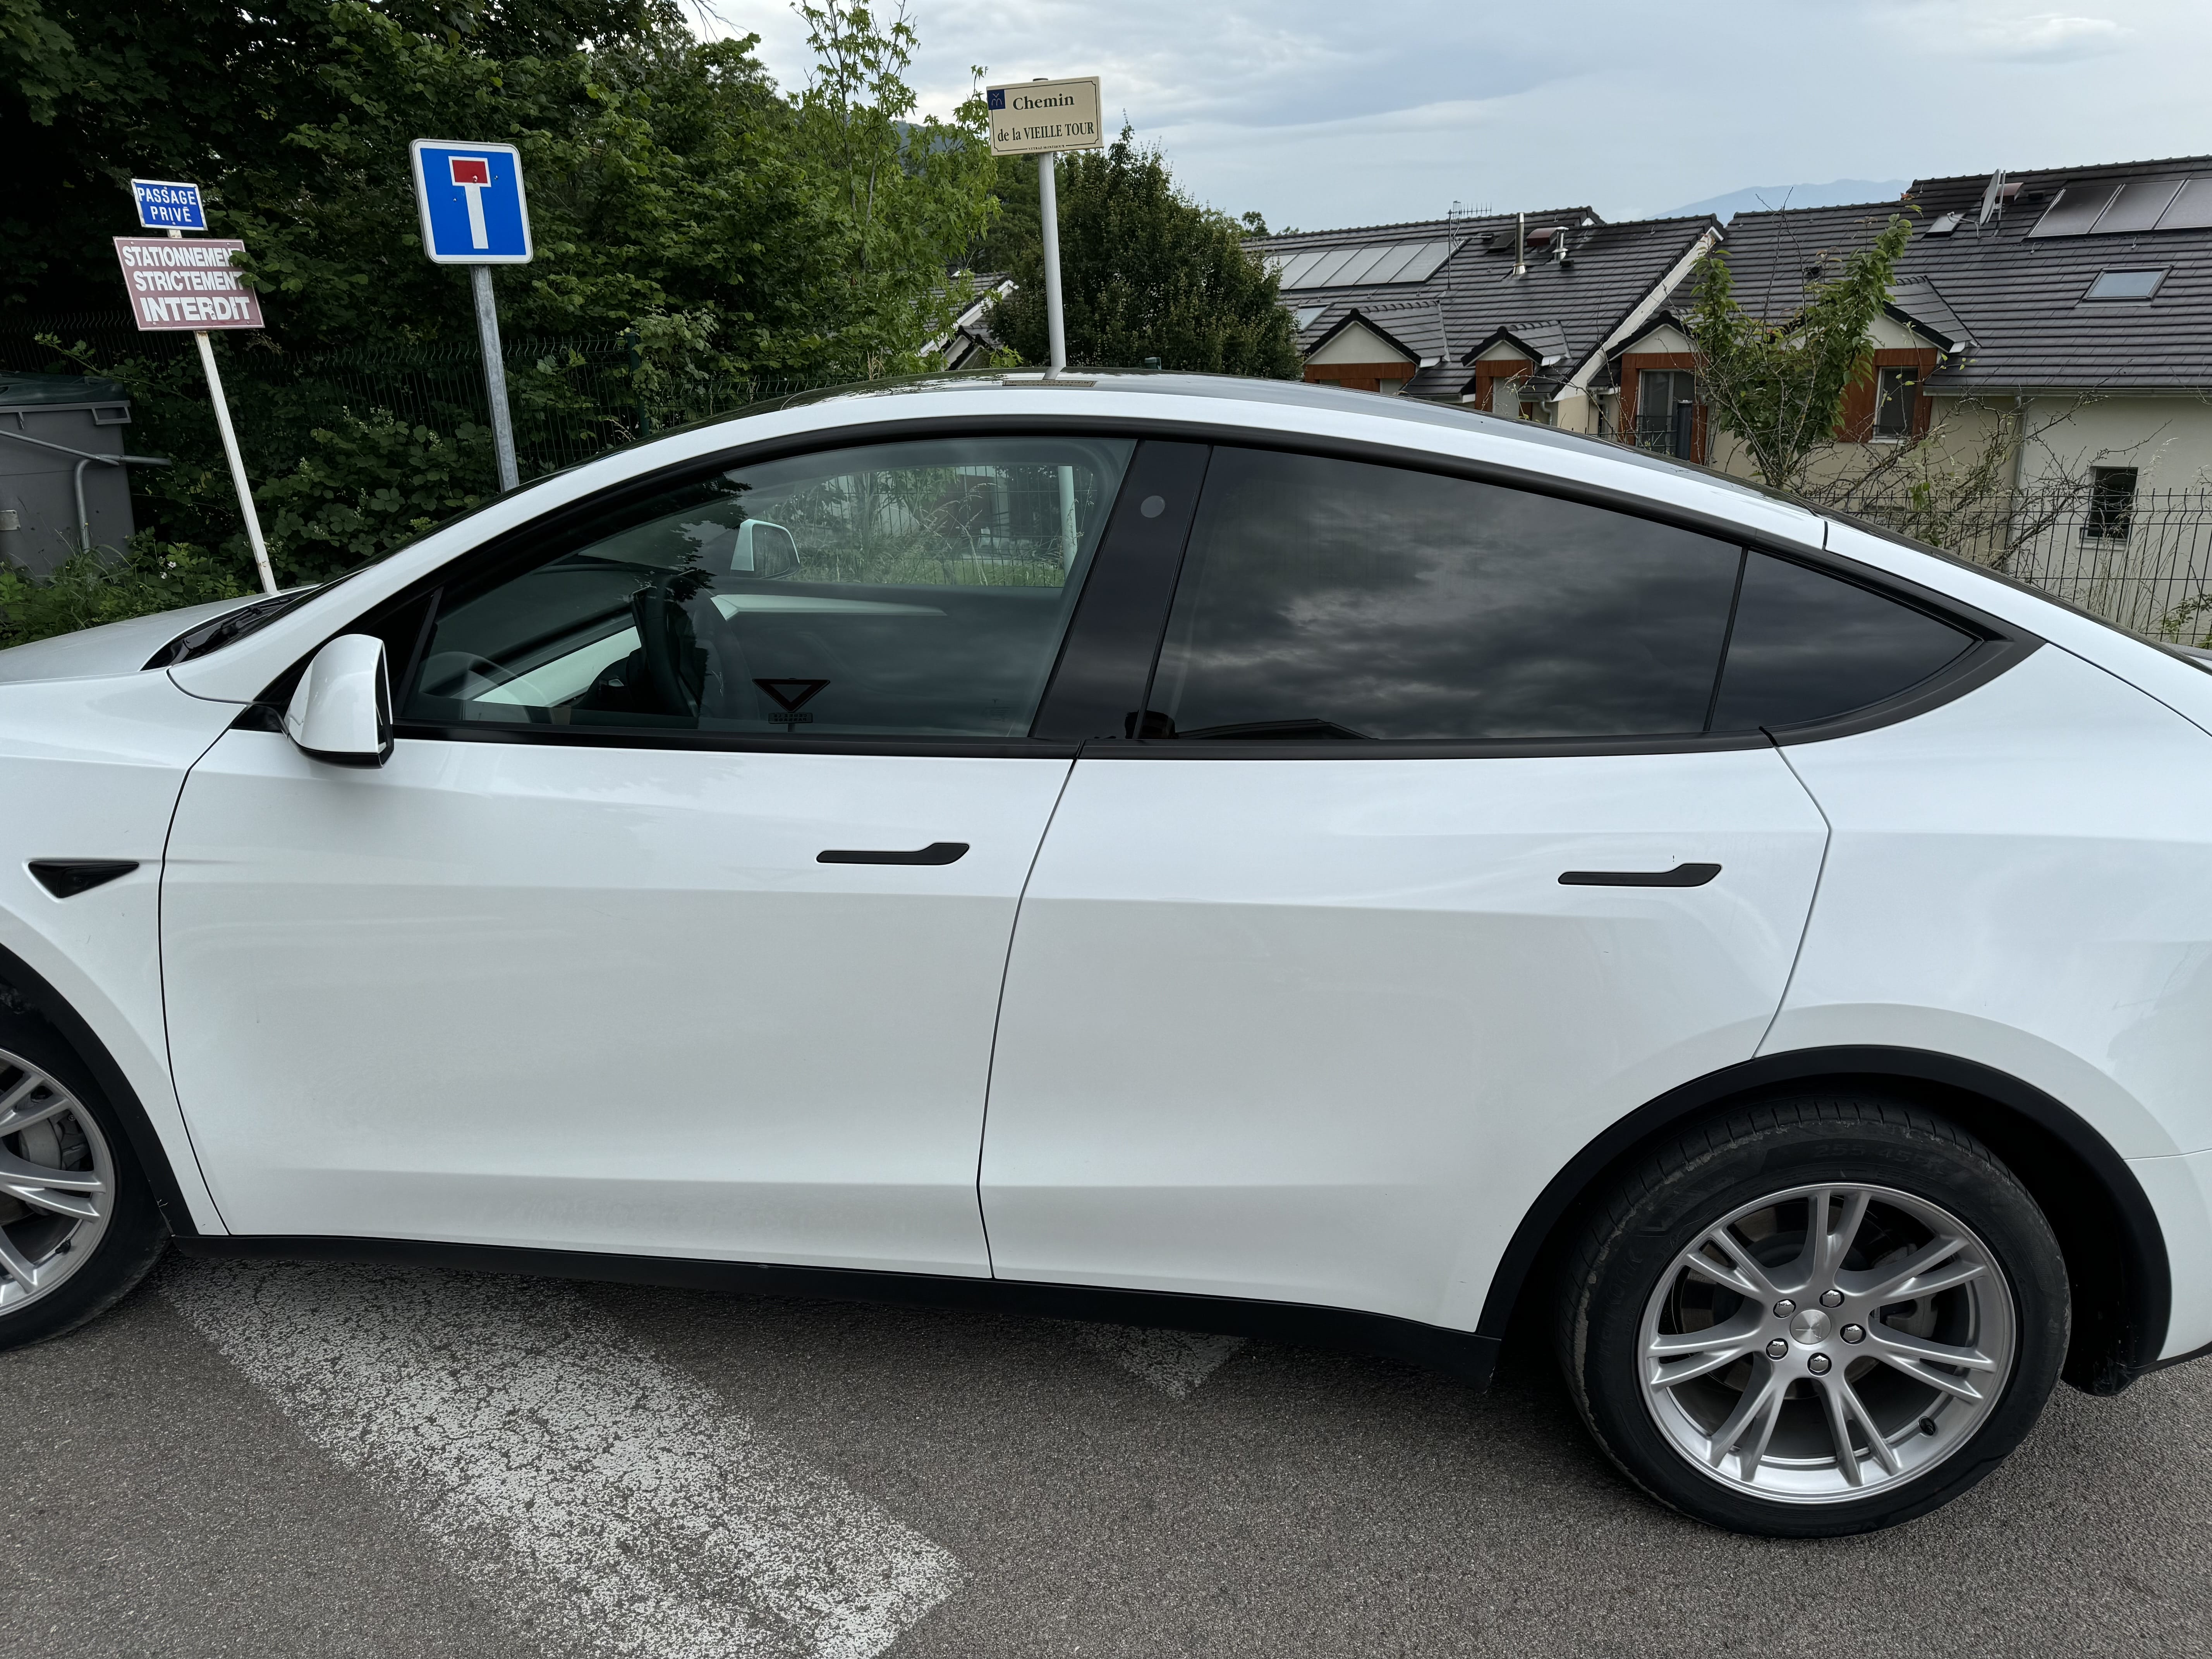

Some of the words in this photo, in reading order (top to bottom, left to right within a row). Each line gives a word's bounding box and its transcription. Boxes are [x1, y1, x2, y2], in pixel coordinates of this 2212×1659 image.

[1013, 93, 1075, 110] Chemin
[998, 129, 1009, 142] de
[1012, 127, 1021, 141] la
[1024, 124, 1063, 140] VIEILLE
[1065, 122, 1094, 136] TOUR
[137, 187, 197, 205] PASSAGE
[150, 206, 192, 223] PRIVÉ
[122, 246, 241, 267] STATIONNEMEN
[133, 271, 243, 291] STRICTEMENT
[140, 296, 250, 322] INTERDIT
